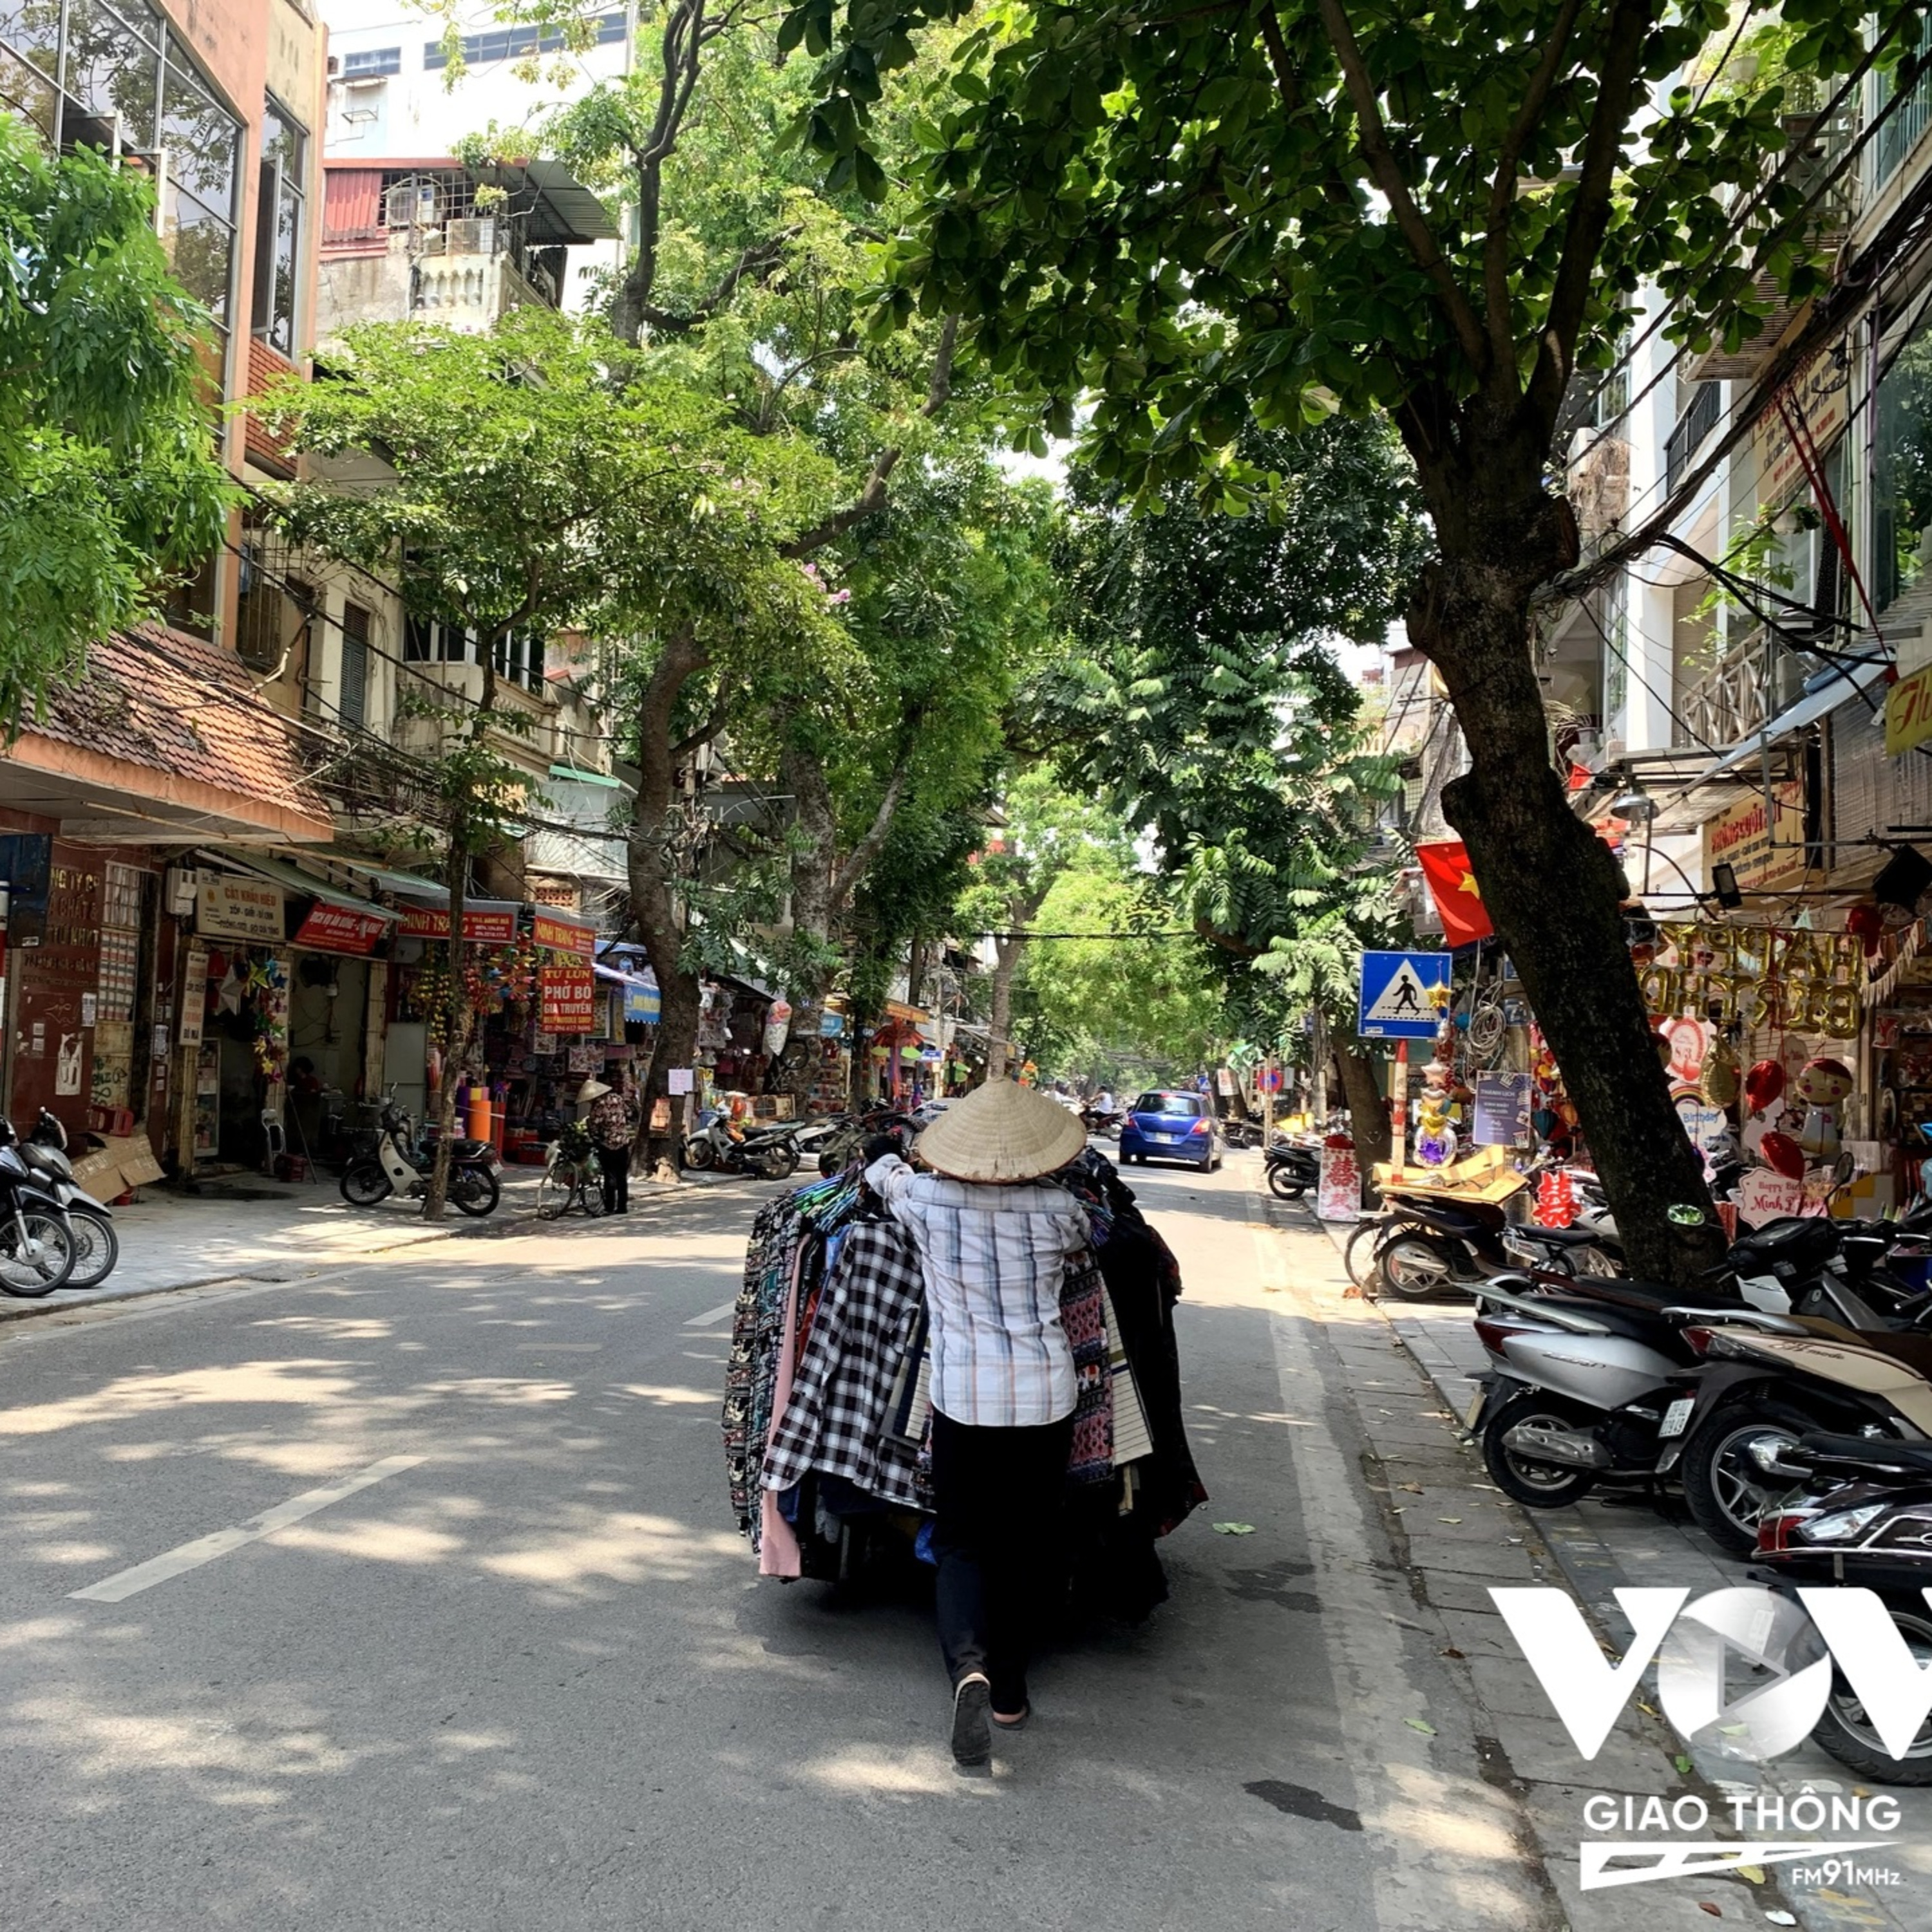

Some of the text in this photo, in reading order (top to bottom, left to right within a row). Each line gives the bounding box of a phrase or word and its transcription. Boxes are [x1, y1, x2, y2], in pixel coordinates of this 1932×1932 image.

[433, 914, 469, 933] TRAG
[536, 922, 553, 942] MINH
[556, 926, 574, 946] TRANG
[544, 980, 591, 999] PHỞ BÒ
[544, 1003, 558, 1014] GIA
[1759, 1181, 1783, 1193] Happy
[1750, 1195, 1783, 1212] Minh
